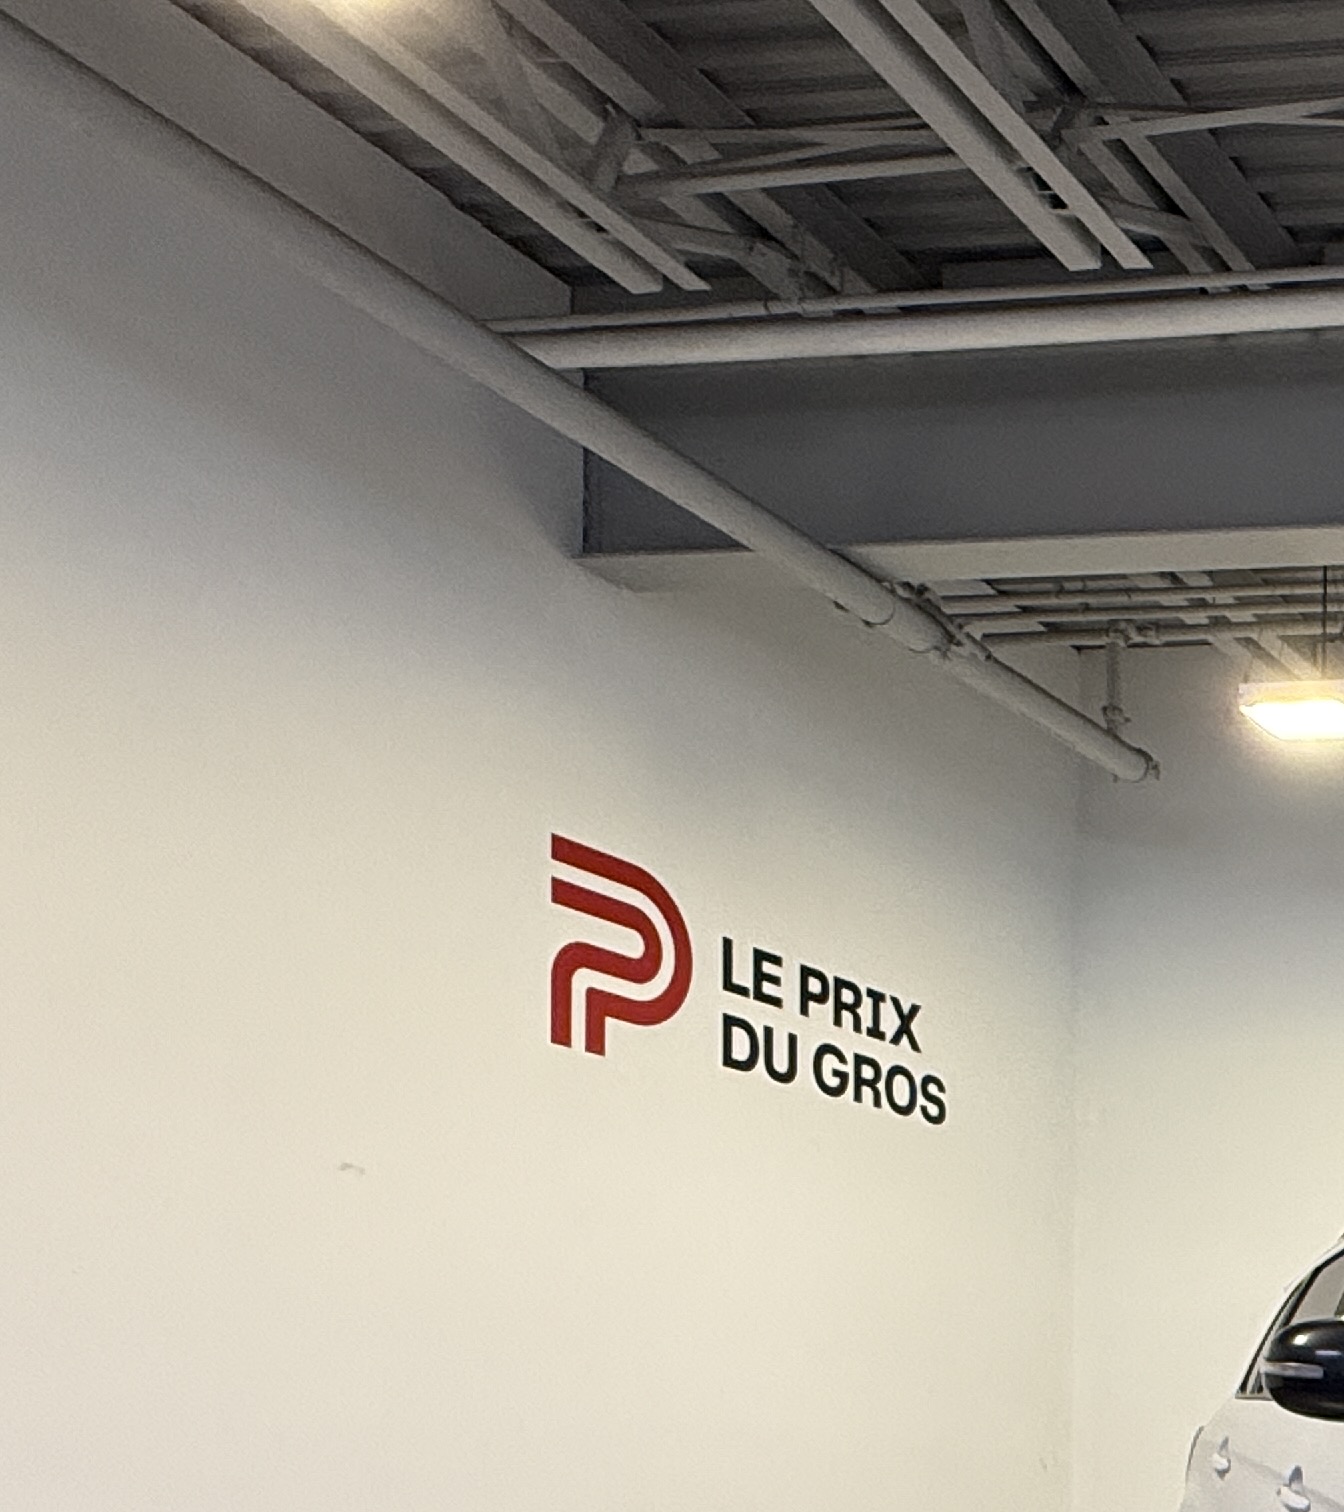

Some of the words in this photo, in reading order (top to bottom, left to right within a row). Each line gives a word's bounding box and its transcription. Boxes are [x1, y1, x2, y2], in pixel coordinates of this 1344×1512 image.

[722, 936, 784, 1010] LE
[799, 963, 922, 1054] PRIX
[722, 1012, 798, 1085] DU
[812, 1042, 947, 1126] GROS
